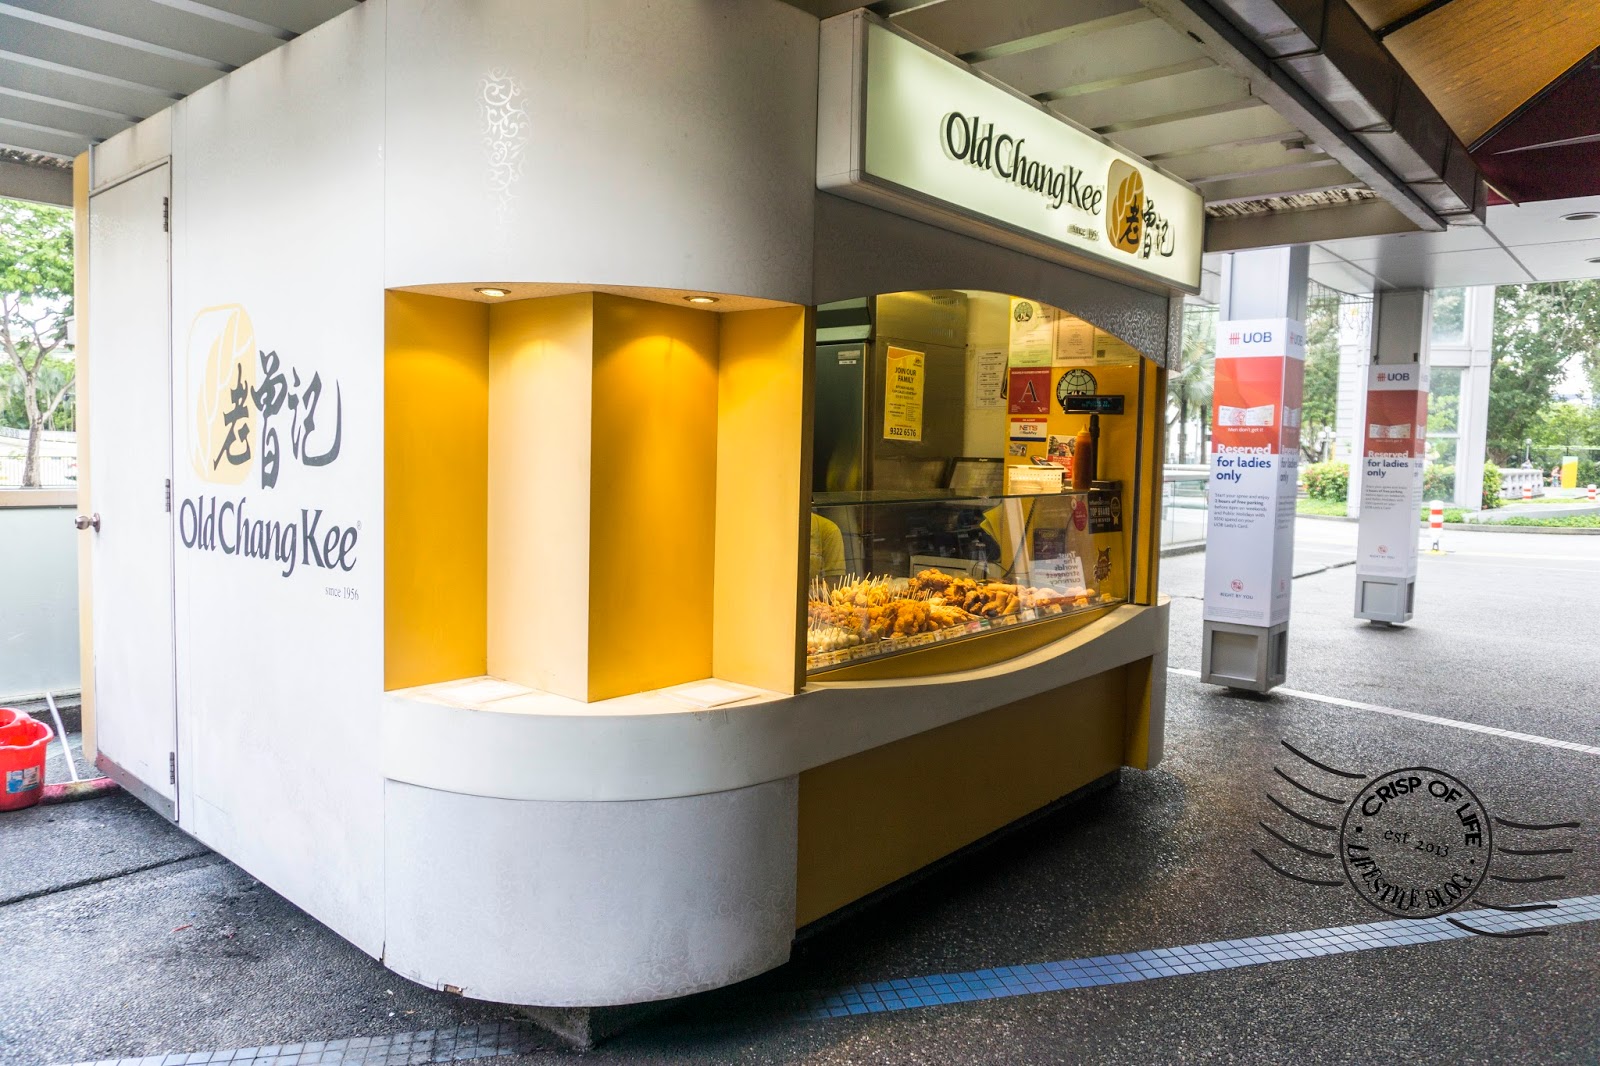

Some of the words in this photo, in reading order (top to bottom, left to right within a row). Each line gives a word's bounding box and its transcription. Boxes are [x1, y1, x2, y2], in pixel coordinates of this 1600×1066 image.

[1243, 331, 1272, 344] UOB
[894, 367, 906, 375] JOIN
[897, 375, 914, 383] FAMILY
[1387, 372, 1410, 381] UOB
[1018, 380, 1040, 403] A
[889, 427, 903, 436] 9322
[903, 428, 917, 437] 6576
[1217, 443, 1272, 455] Reserved
[1368, 450, 1409, 458] Reserved
[1217, 456, 1234, 467] for
[1237, 457, 1271, 468] ladies
[1367, 459, 1381, 467] for
[1383, 459, 1409, 468] ladies
[1216, 470, 1242, 484] only
[1367, 469, 1386, 478] only
[325, 586, 342, 598] since
[343, 586, 360, 601] 1956
